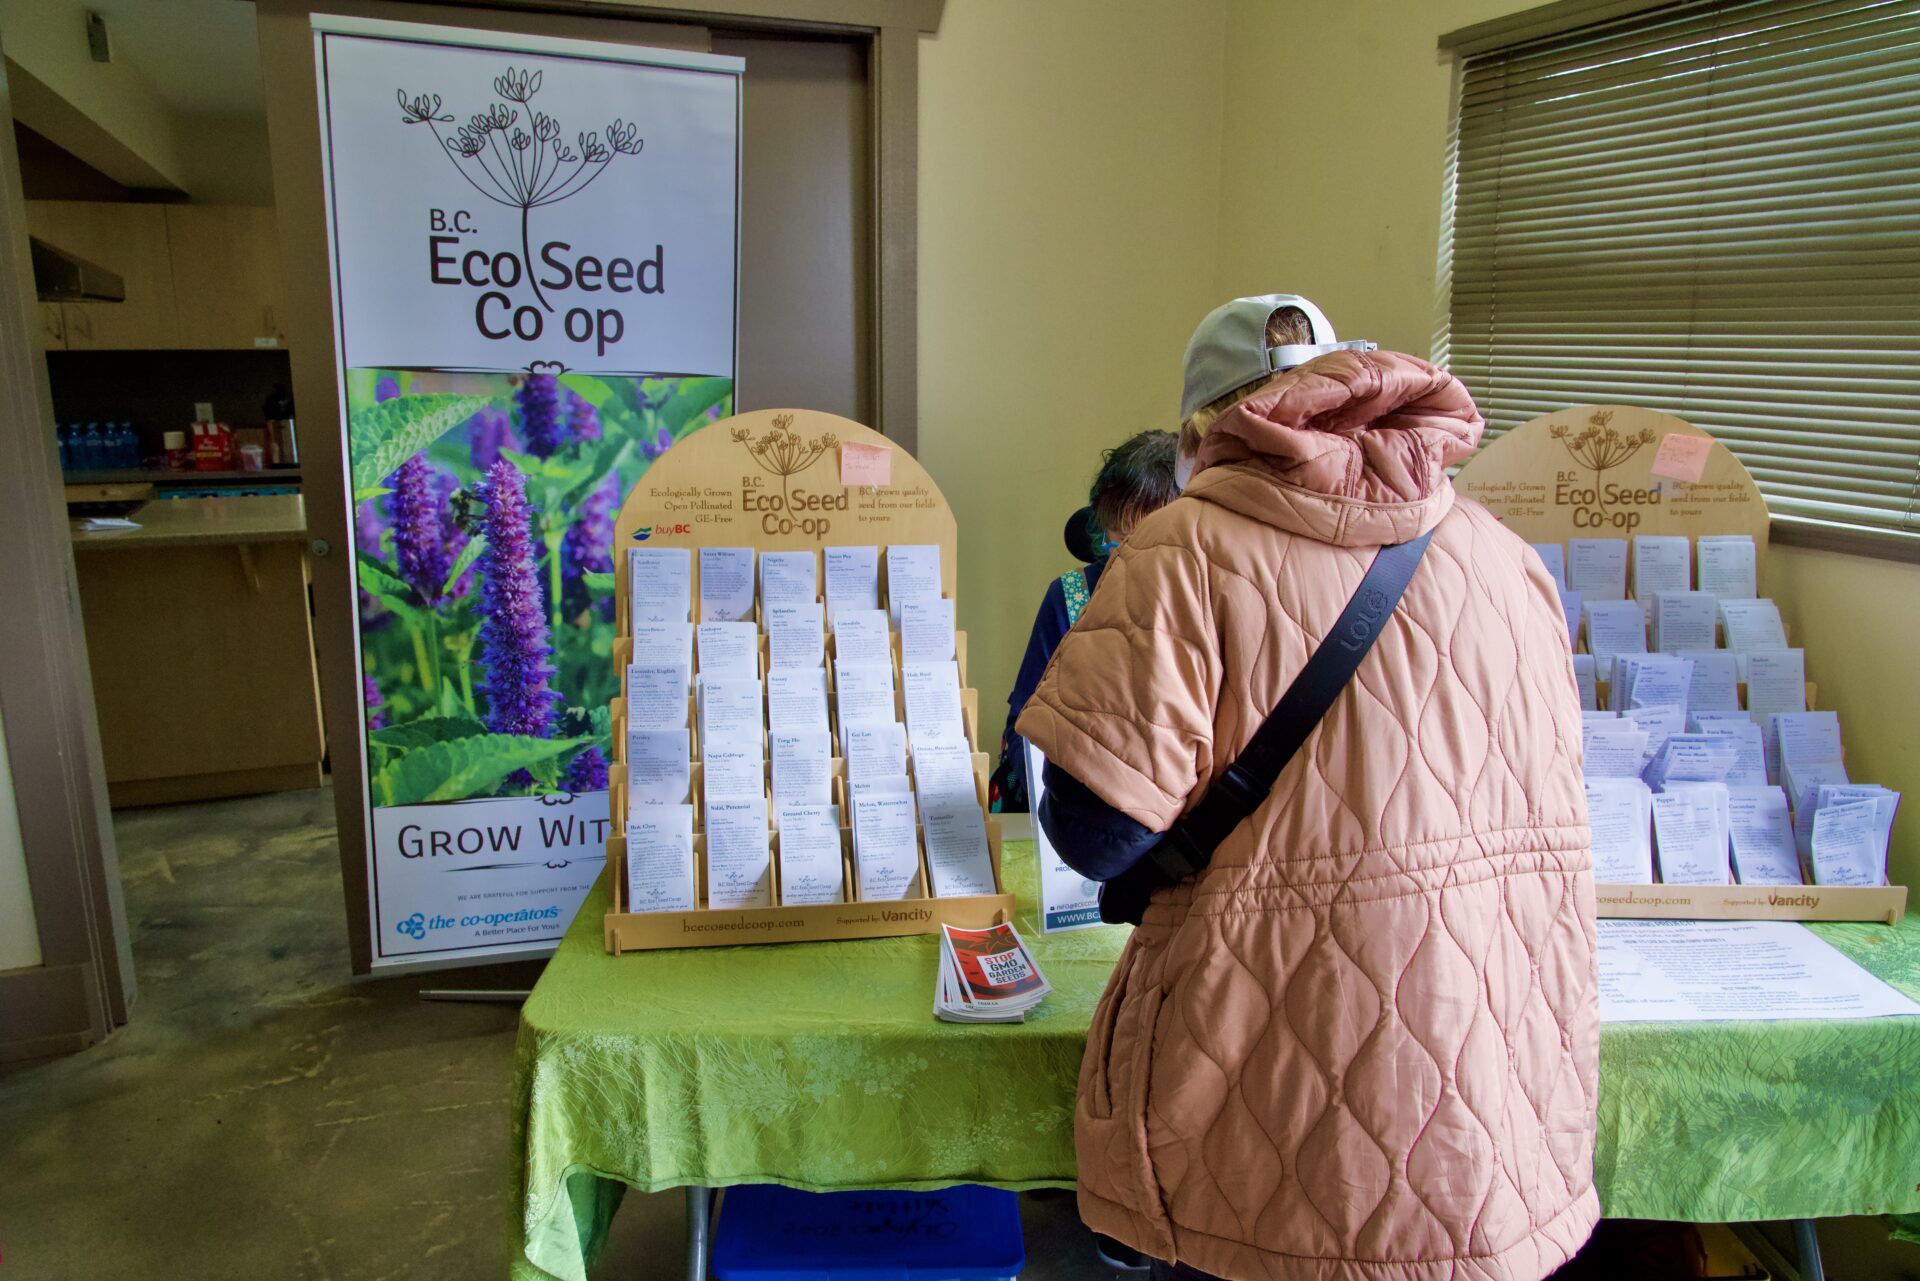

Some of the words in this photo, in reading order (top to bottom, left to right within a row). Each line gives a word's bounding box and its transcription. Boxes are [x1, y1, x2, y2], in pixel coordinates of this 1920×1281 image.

[430, 209, 477, 233] B.C.
[429, 236, 521, 288] Eco
[540, 242, 665, 294] Seed
[742, 476, 764, 487] B.C.
[1556, 471, 1578, 482] B.C.
[902, 486, 929, 497] quality
[1467, 481, 1516, 493] Ecologically
[1519, 483, 1546, 491] Grown
[1716, 480, 1744, 491] quality
[650, 487, 701, 498] Ecologically
[703, 487, 733, 497] Grown
[1555, 484, 1596, 505] Eco
[1603, 482, 1661, 505] Seed
[664, 501, 688, 512] Open
[690, 500, 733, 510] Pollinated
[742, 489, 784, 512] Eco
[791, 487, 849, 511] Seed
[858, 499, 876, 509] seed
[877, 498, 898, 509] from
[915, 498, 936, 509] fields
[695, 513, 733, 523] GE-Free
[1507, 507, 1545, 516] GE-Free
[858, 514, 868, 522] to
[869, 515, 890, 523] yours
[398, 824, 522, 859] GROW
[539, 814, 609, 848] WIT
[483, 891, 514, 899] GRATEFUL
[530, 887, 558, 895] SUPPORT
[1768, 894, 1820, 909] Vancity
[428, 911, 456, 931] the
[683, 915, 805, 934] bcecoseedcoop.com
[836, 914, 870, 926] Supported
[881, 908, 933, 923] Vancity
[482, 928, 505, 937] Better
[506, 926, 525, 934] Place
[527, 924, 539, 932] For
[985, 952, 1015, 965] STOP
[988, 964, 1027, 979] GARDEN
[990, 959, 1018, 972] GMO
[995, 971, 1026, 984] SEEDS
